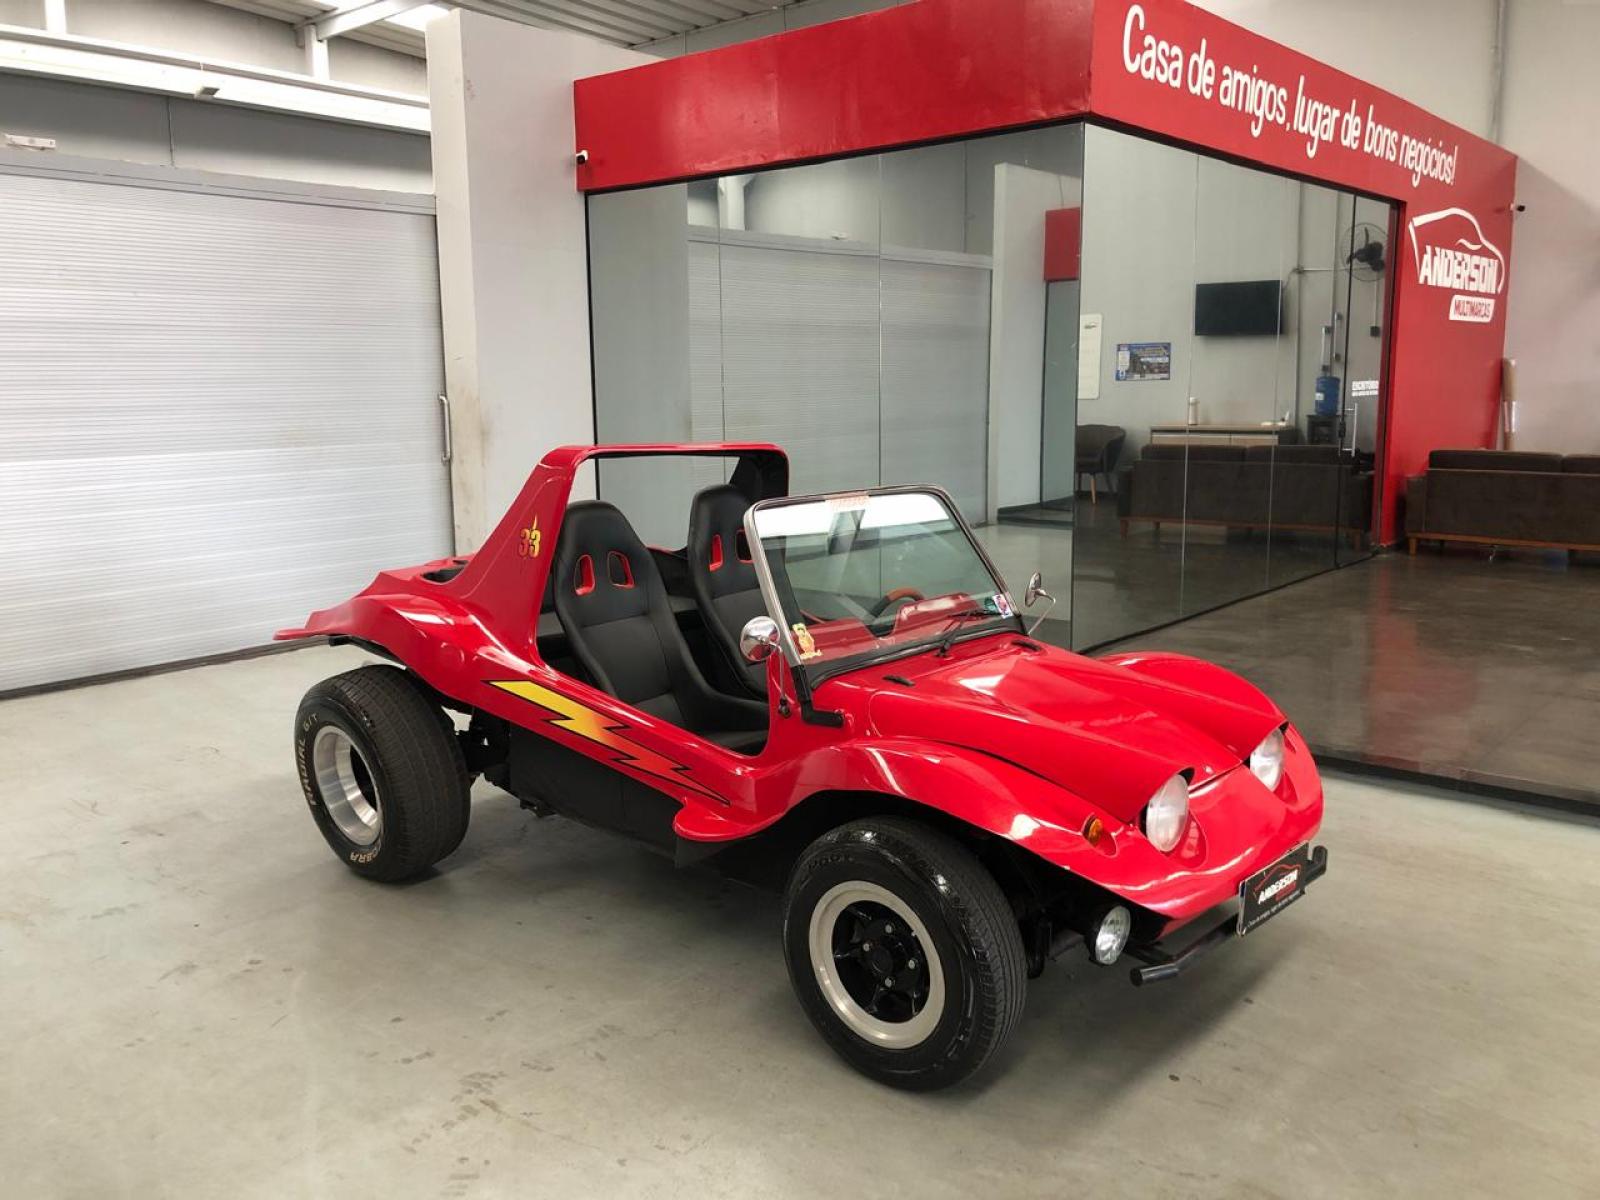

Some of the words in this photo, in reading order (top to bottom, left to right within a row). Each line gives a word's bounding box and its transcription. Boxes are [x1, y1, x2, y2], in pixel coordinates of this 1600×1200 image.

[1123, 4, 1183, 89] Casa
[1187, 38, 1215, 99] de
[1219, 64, 1290, 138] amigos,
[1293, 75, 1340, 158] lugar
[1341, 99, 1361, 150] de
[1364, 104, 1398, 162] bons
[1399, 135, 1458, 187] negócios!
[1419, 245, 1498, 294] ANDERSON
[1454, 299, 1491, 318] MULTIMARCAS
[299, 740, 317, 805] RADIAL
